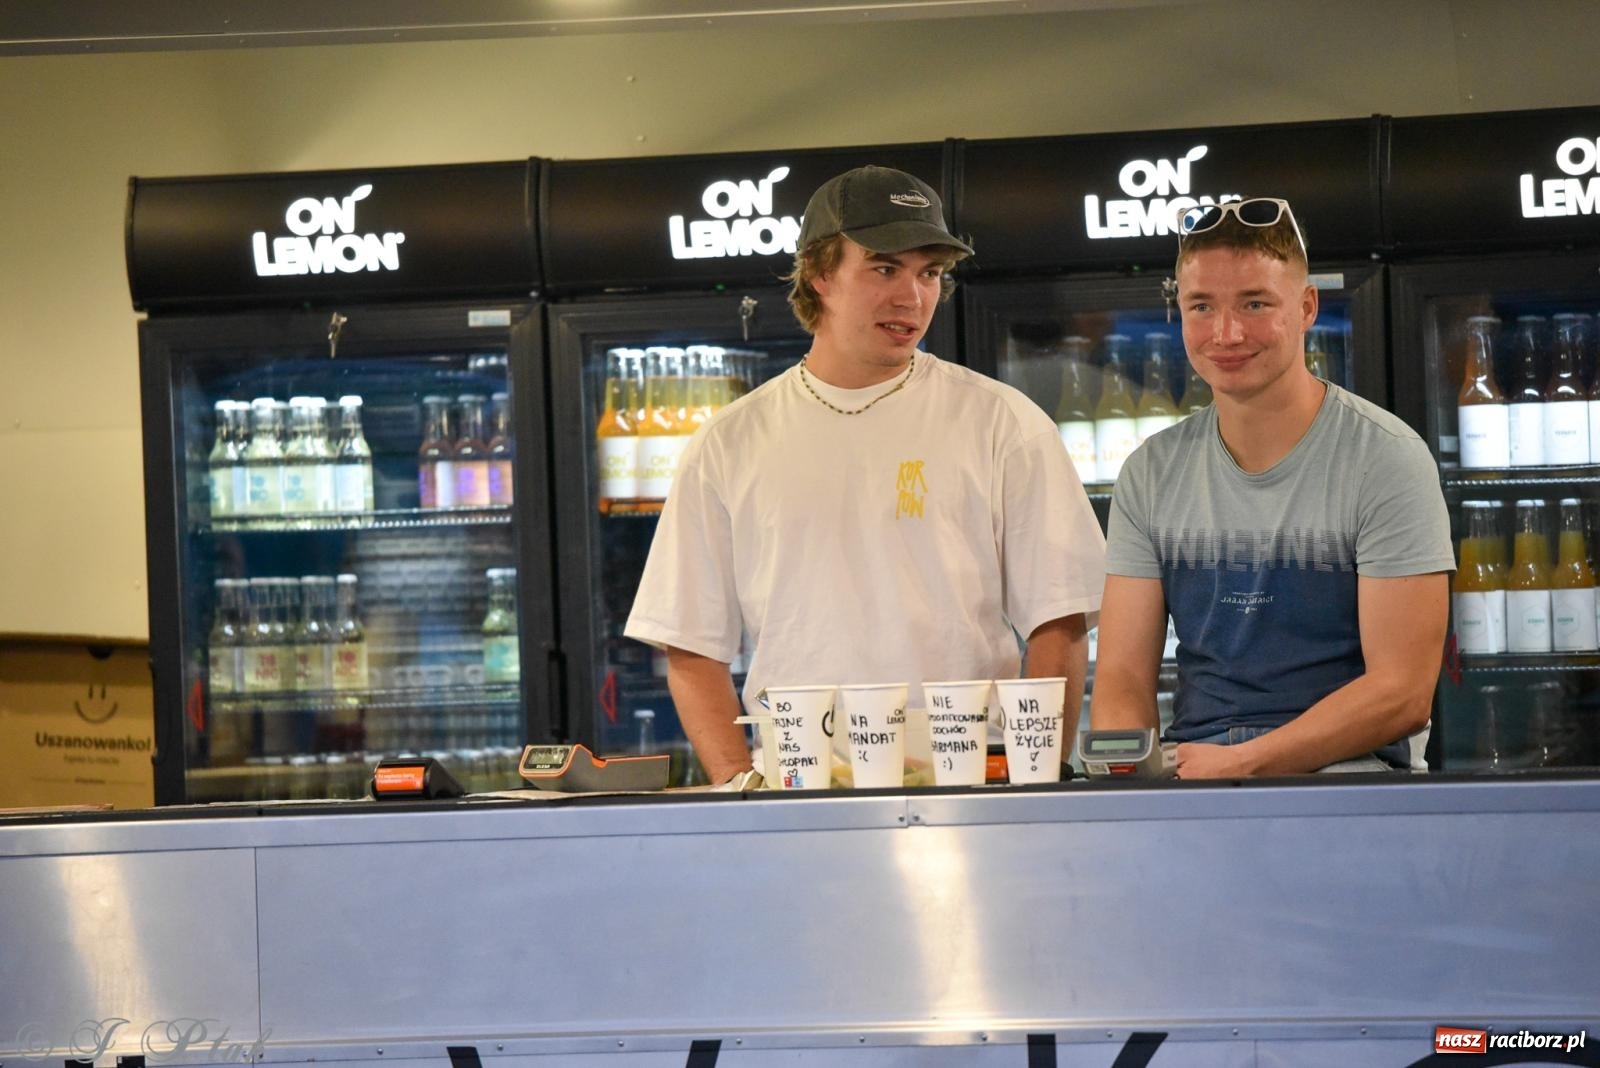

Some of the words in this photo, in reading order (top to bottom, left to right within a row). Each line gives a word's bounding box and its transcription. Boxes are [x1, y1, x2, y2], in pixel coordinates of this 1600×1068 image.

[1556, 137, 1600, 175] O
[1119, 158, 1191, 197] ON
[702, 179, 773, 218] ON
[286, 196, 356, 236] ON
[1085, 195, 1237, 238] LEMO
[669, 215, 804, 259] LEMON
[253, 231, 402, 276] LEMON
[776, 702, 791, 712] BO
[932, 695, 953, 709] NIE
[1018, 699, 1040, 713] NA
[850, 713, 868, 728] NA
[1009, 717, 1057, 732] LEPSZE
[778, 743, 801, 753] NAS
[1015, 732, 1054, 749] ŻYCIE
